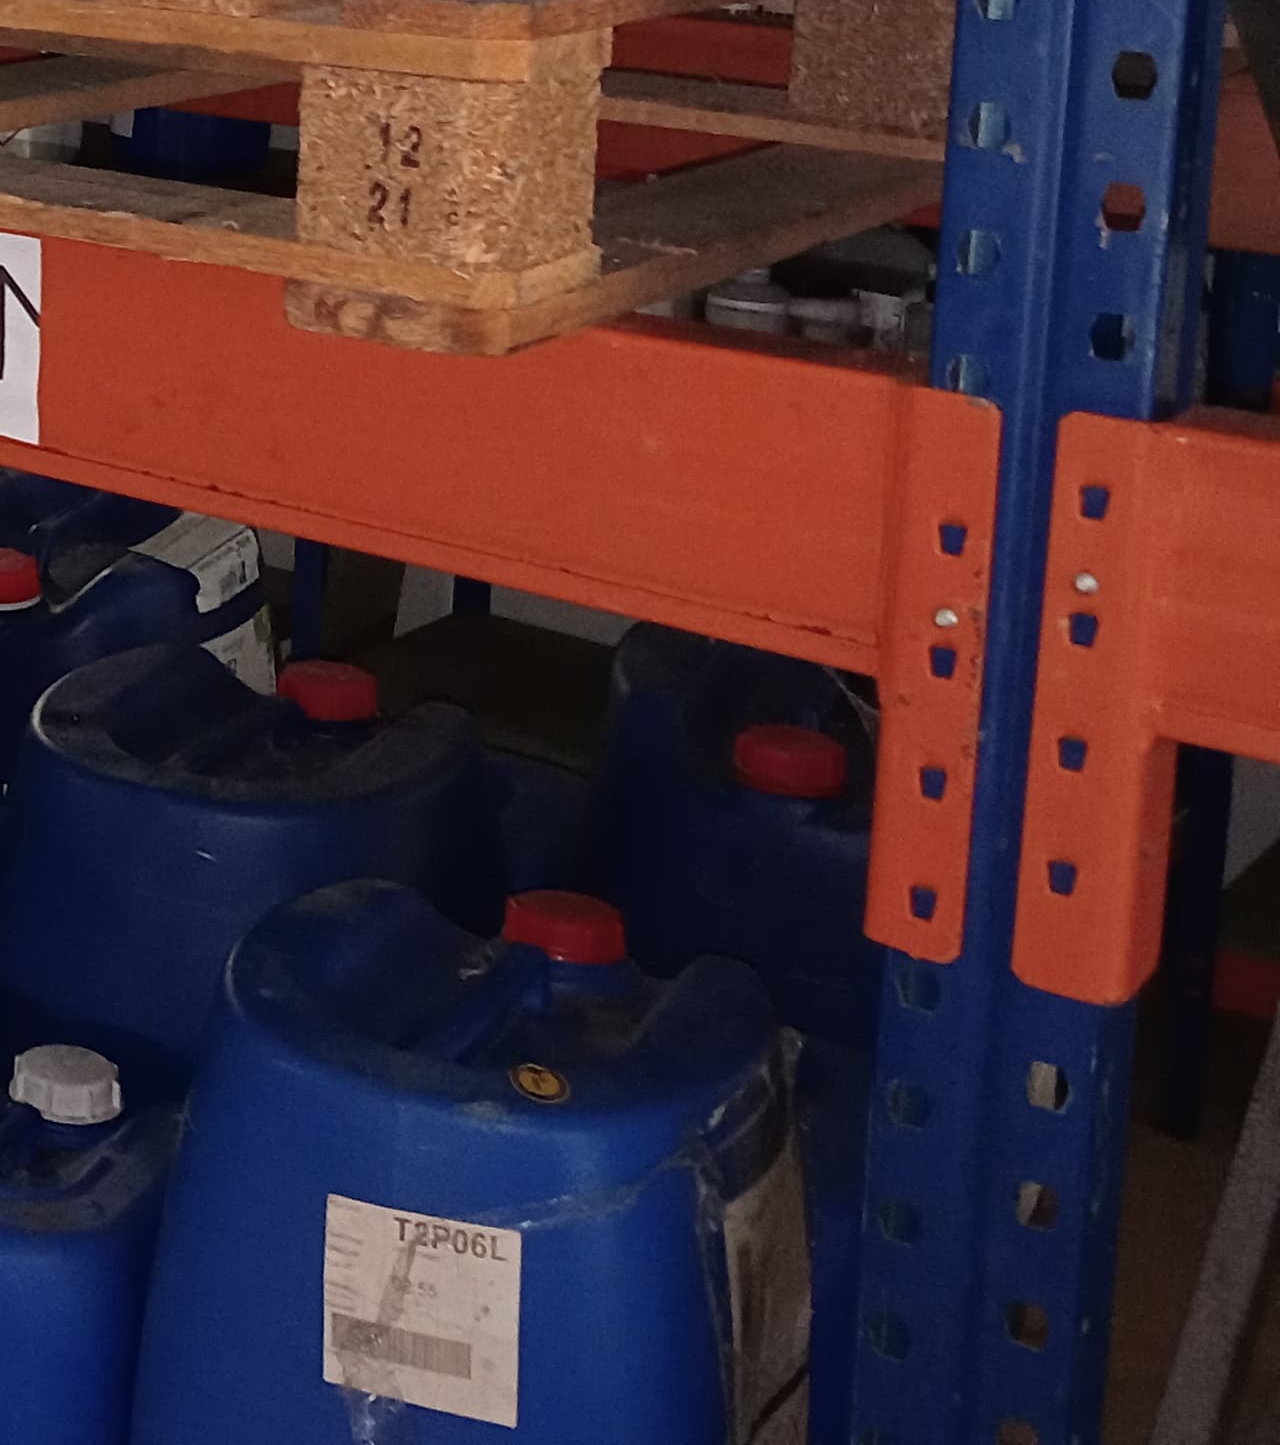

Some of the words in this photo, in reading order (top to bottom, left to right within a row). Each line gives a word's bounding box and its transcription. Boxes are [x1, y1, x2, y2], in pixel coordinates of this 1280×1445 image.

[379, 123, 422, 168] 12
[368, 181, 411, 226] 21
[393, 1216, 509, 1262] T2P06L
